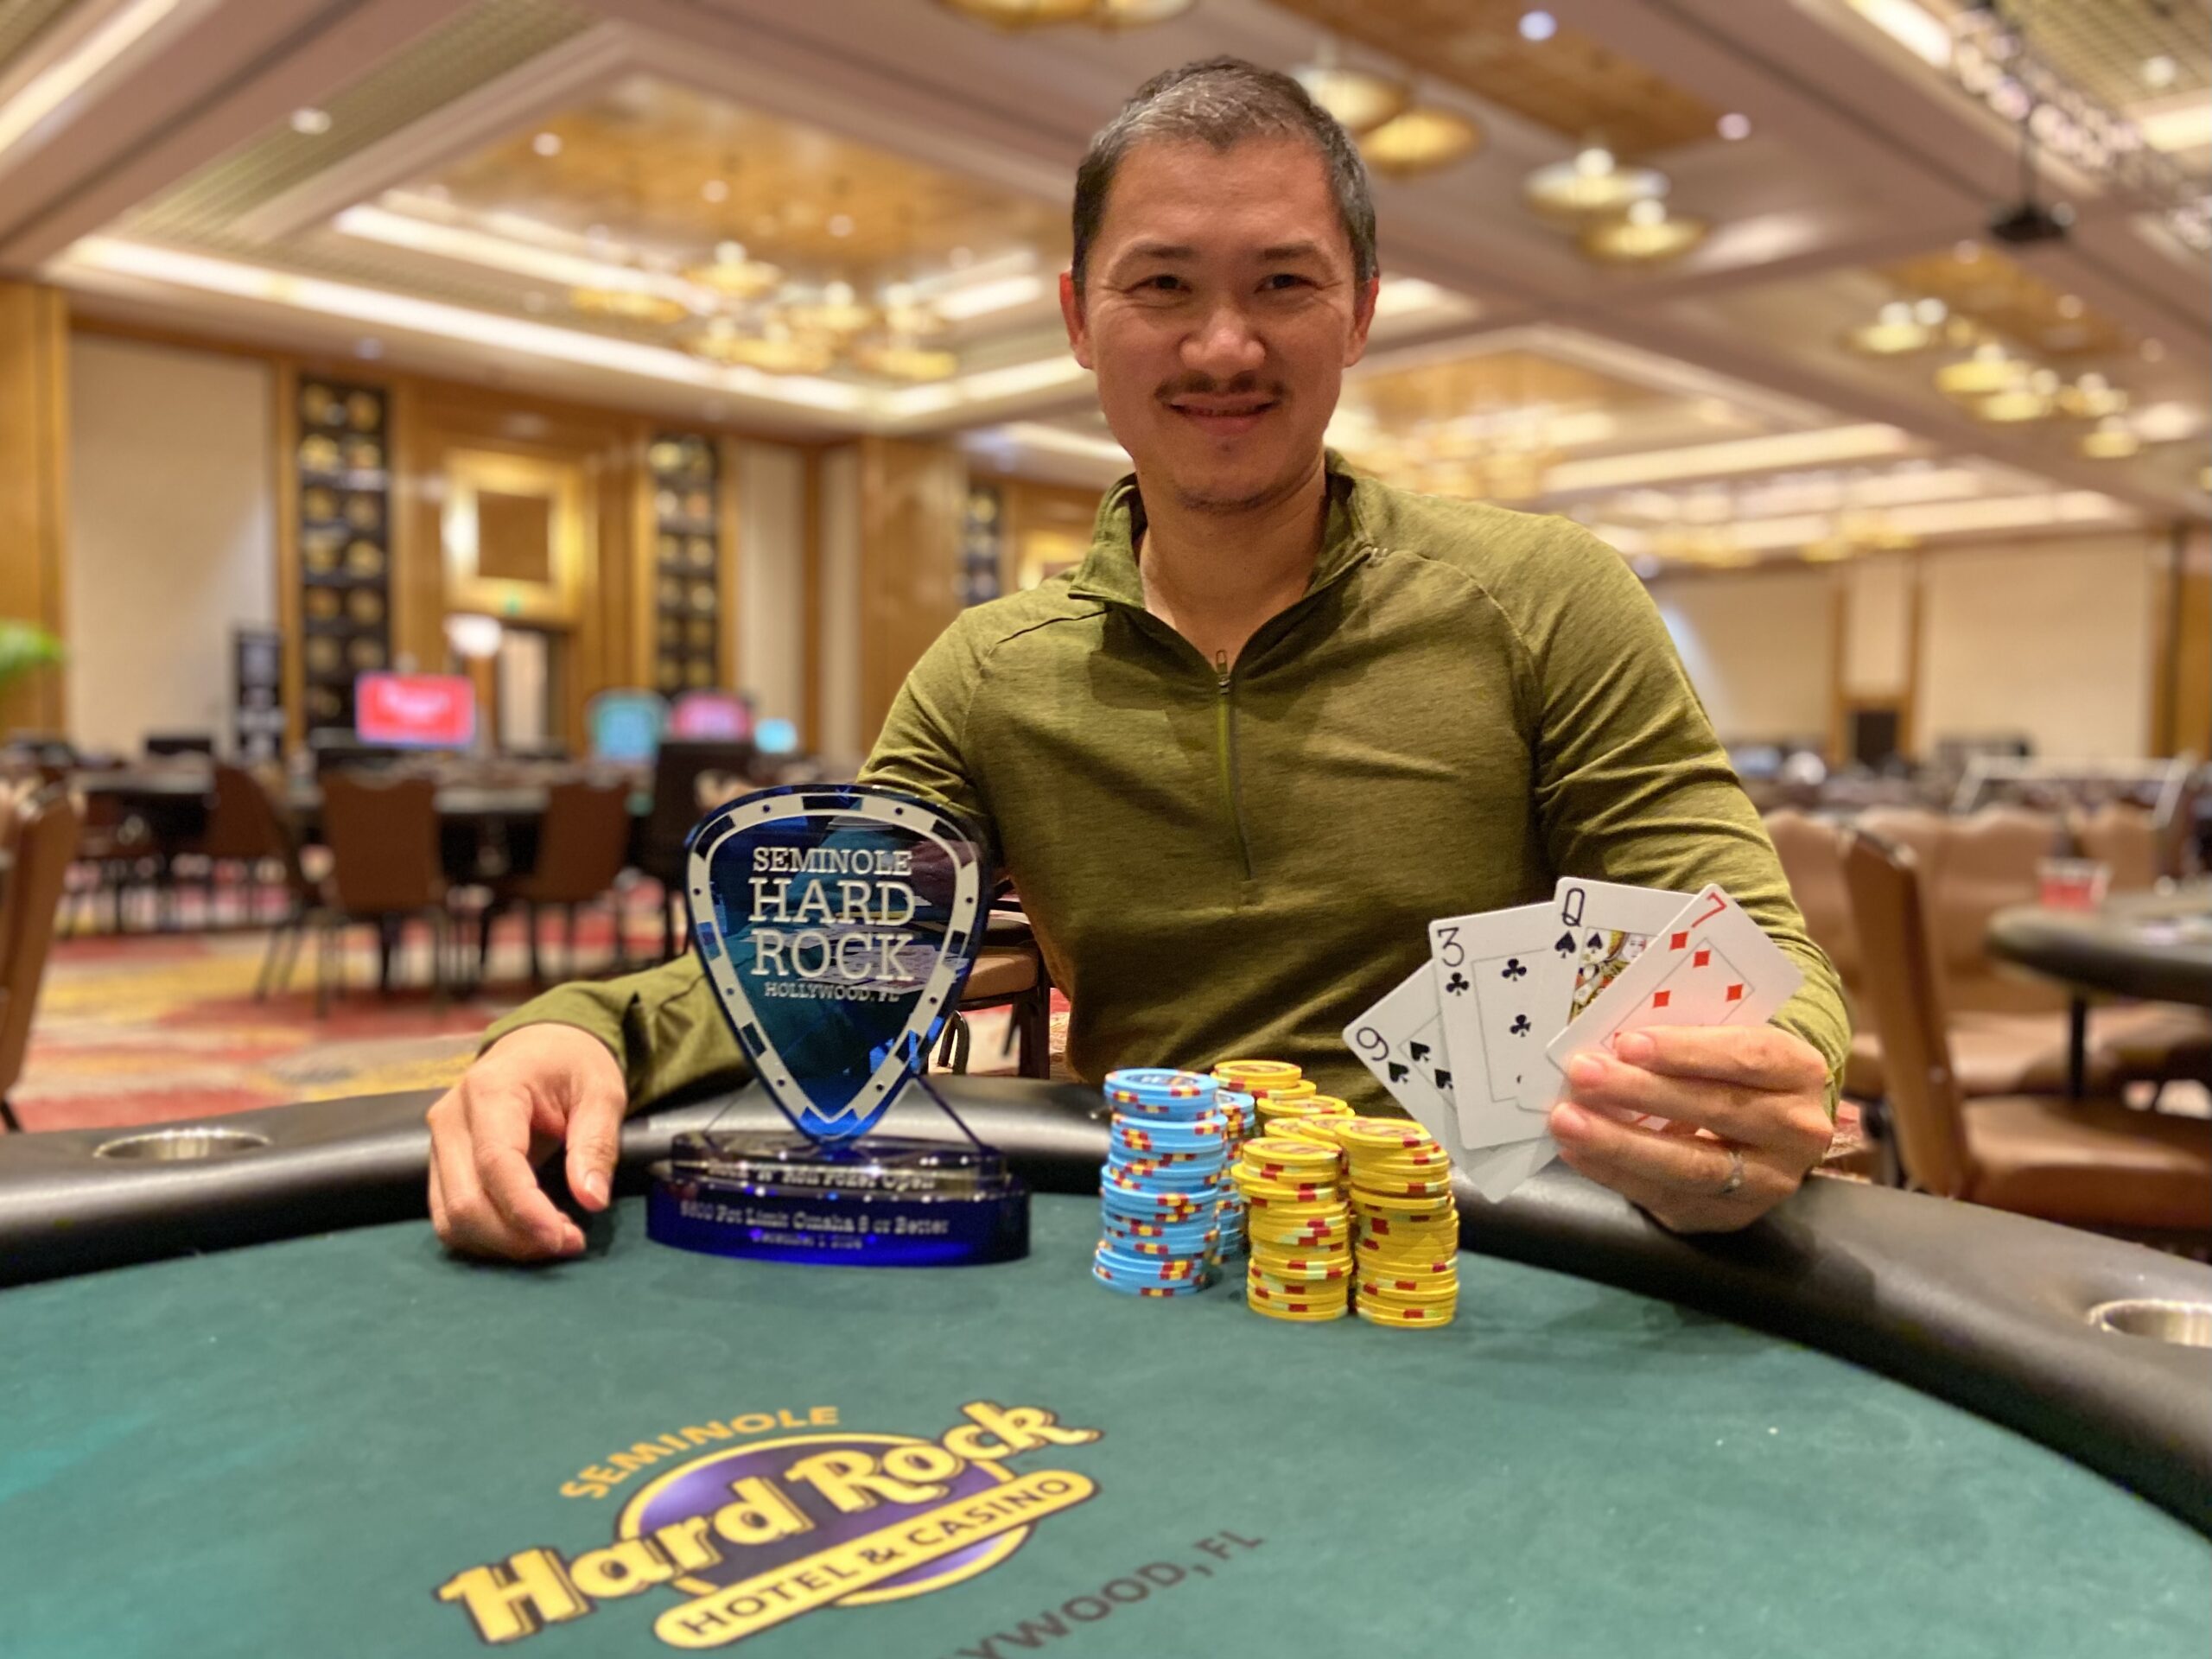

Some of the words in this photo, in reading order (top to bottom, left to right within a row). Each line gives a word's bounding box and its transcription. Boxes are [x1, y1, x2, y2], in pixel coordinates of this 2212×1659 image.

[753, 847, 913, 875] SEMINOLE
[747, 876, 916, 926] HARD
[1560, 887, 1586, 928] Q
[1690, 892, 1727, 929] 7
[750, 928, 915, 982] ROCK
[1436, 926, 1465, 968] 3
[1355, 1026, 1390, 1062] 9
[560, 1407, 839, 1499] SEMINOLE
[435, 1476, 815, 1643] Hard
[785, 1401, 1102, 1514] Rock
[677, 1558, 861, 1636] HOTEL
[858, 1547, 906, 1566] &
[906, 1477, 1072, 1548] CASINO
